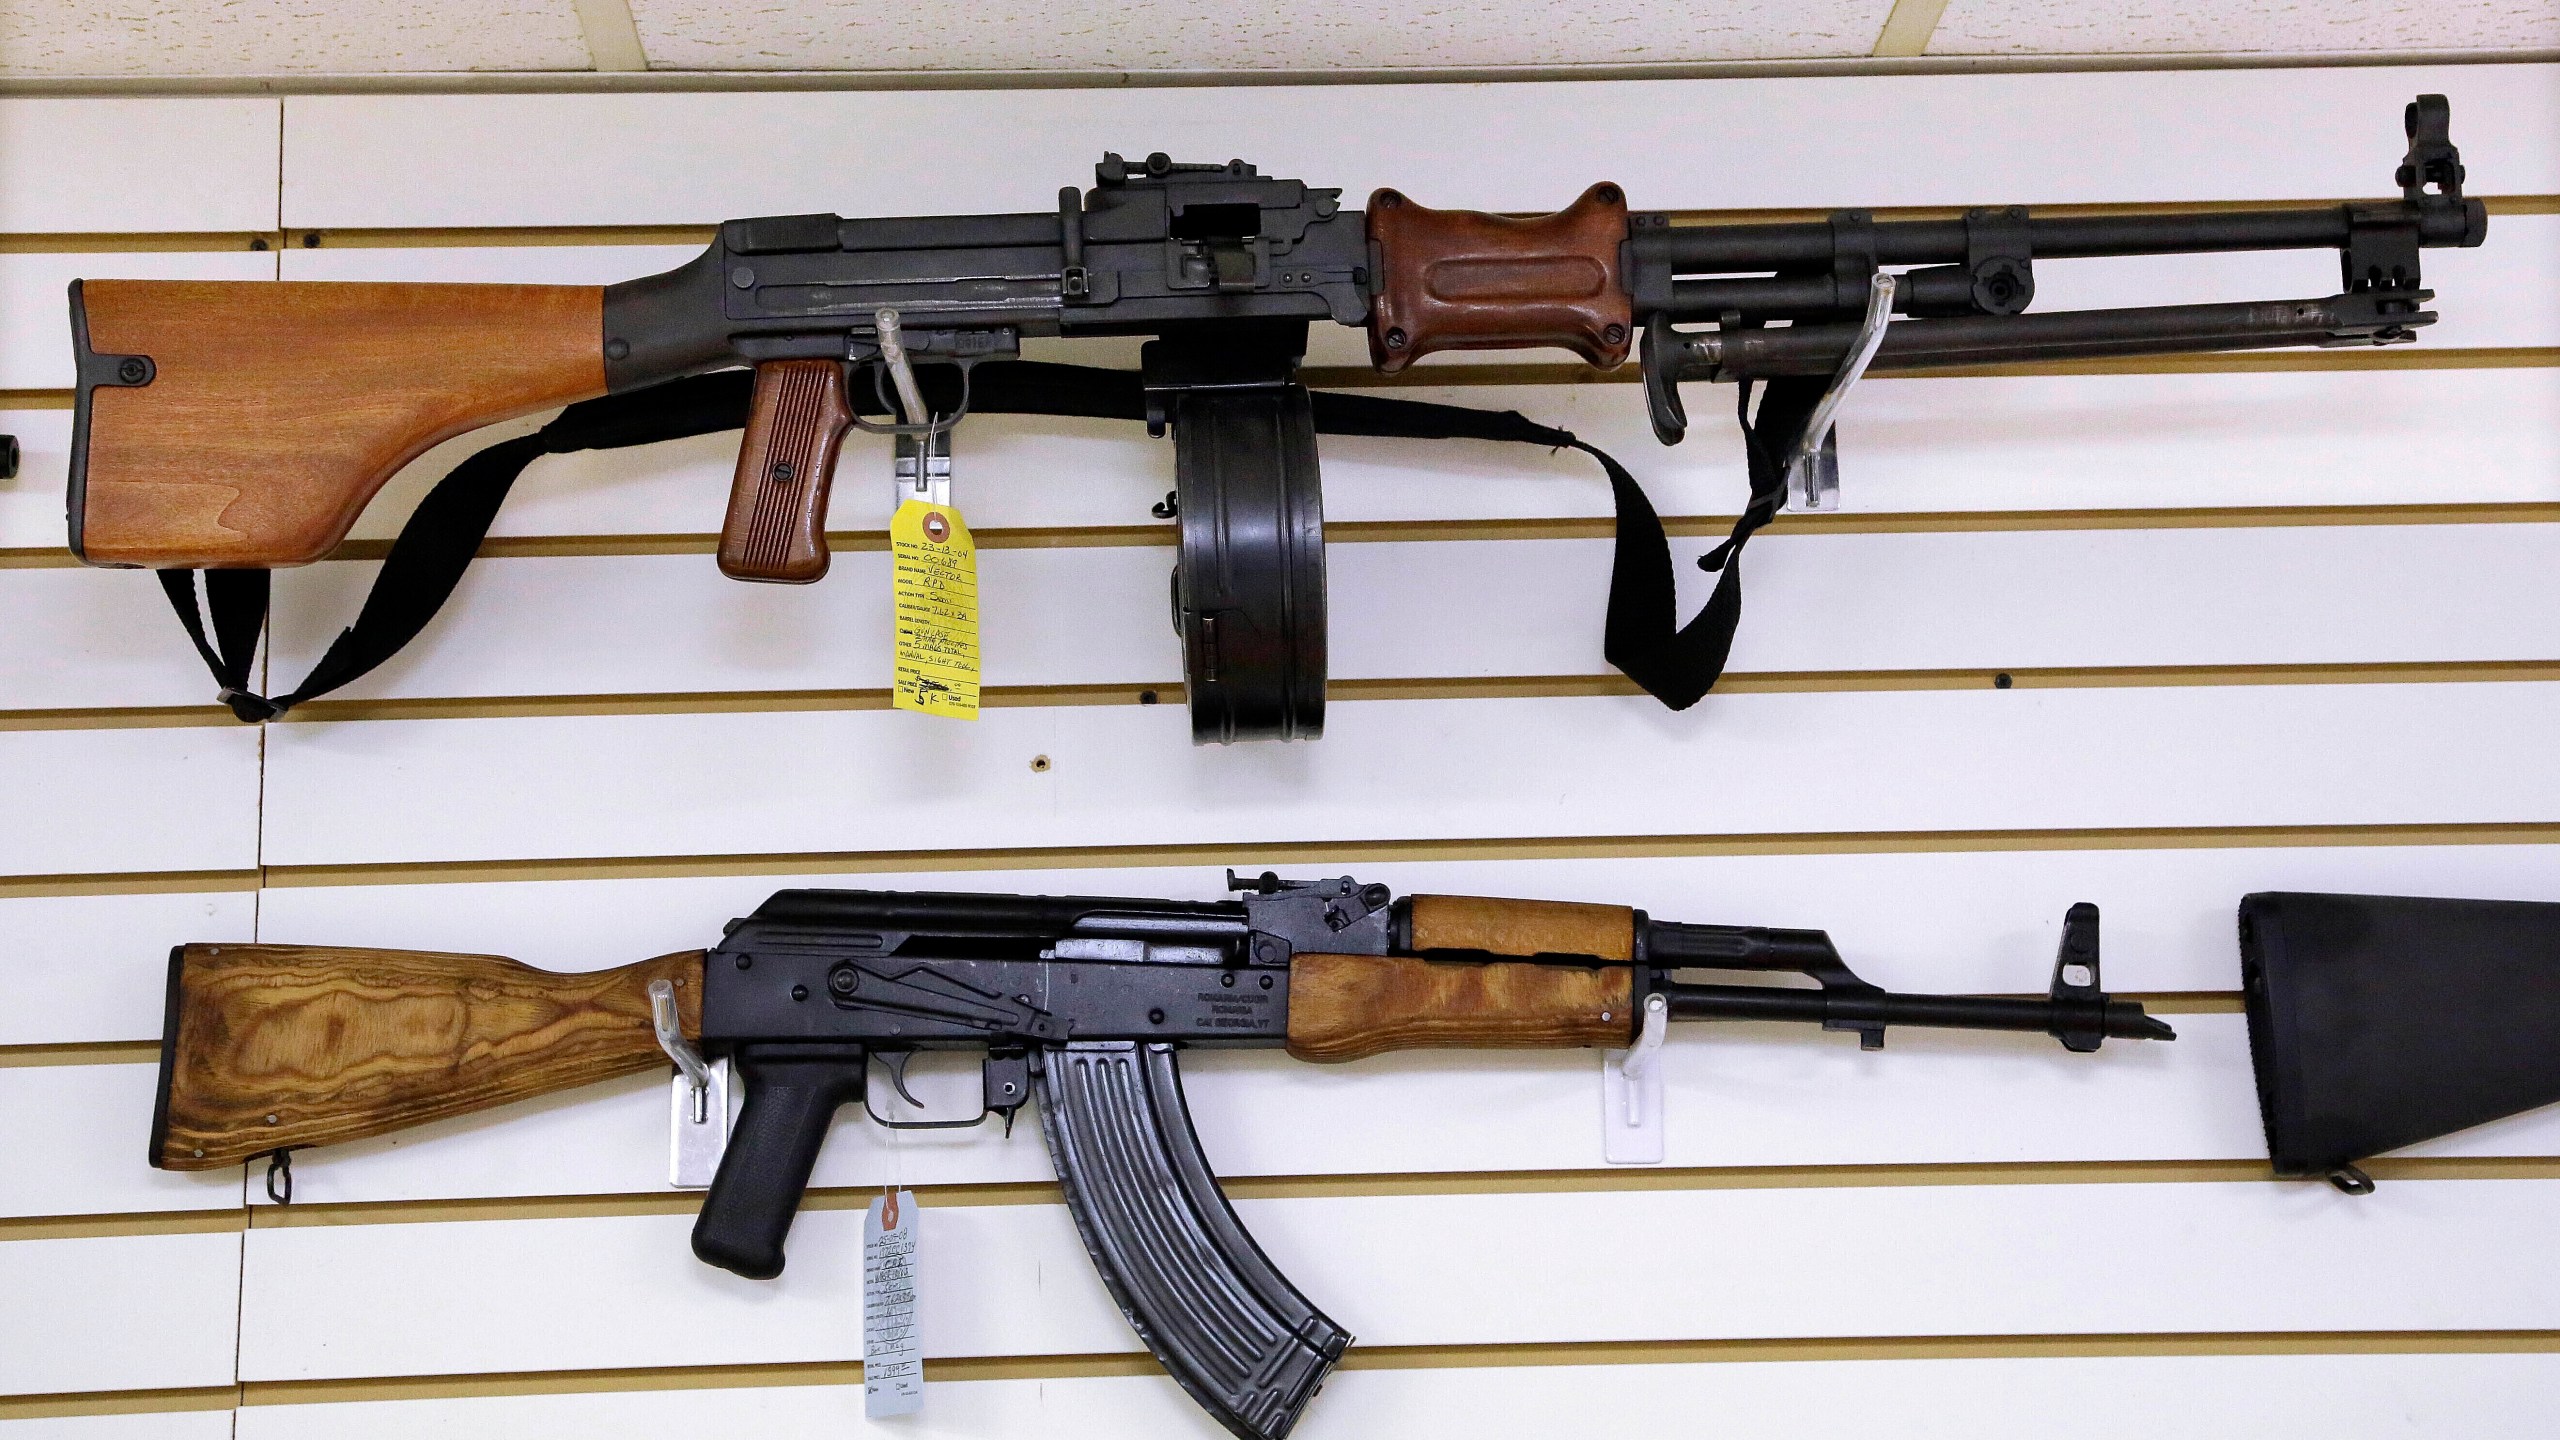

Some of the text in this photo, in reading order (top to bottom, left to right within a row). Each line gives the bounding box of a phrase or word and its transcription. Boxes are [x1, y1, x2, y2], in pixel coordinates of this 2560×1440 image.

[928, 564, 963, 583] VECTOR
[923, 576, 945, 590] RPD
[948, 694, 962, 702] Used
